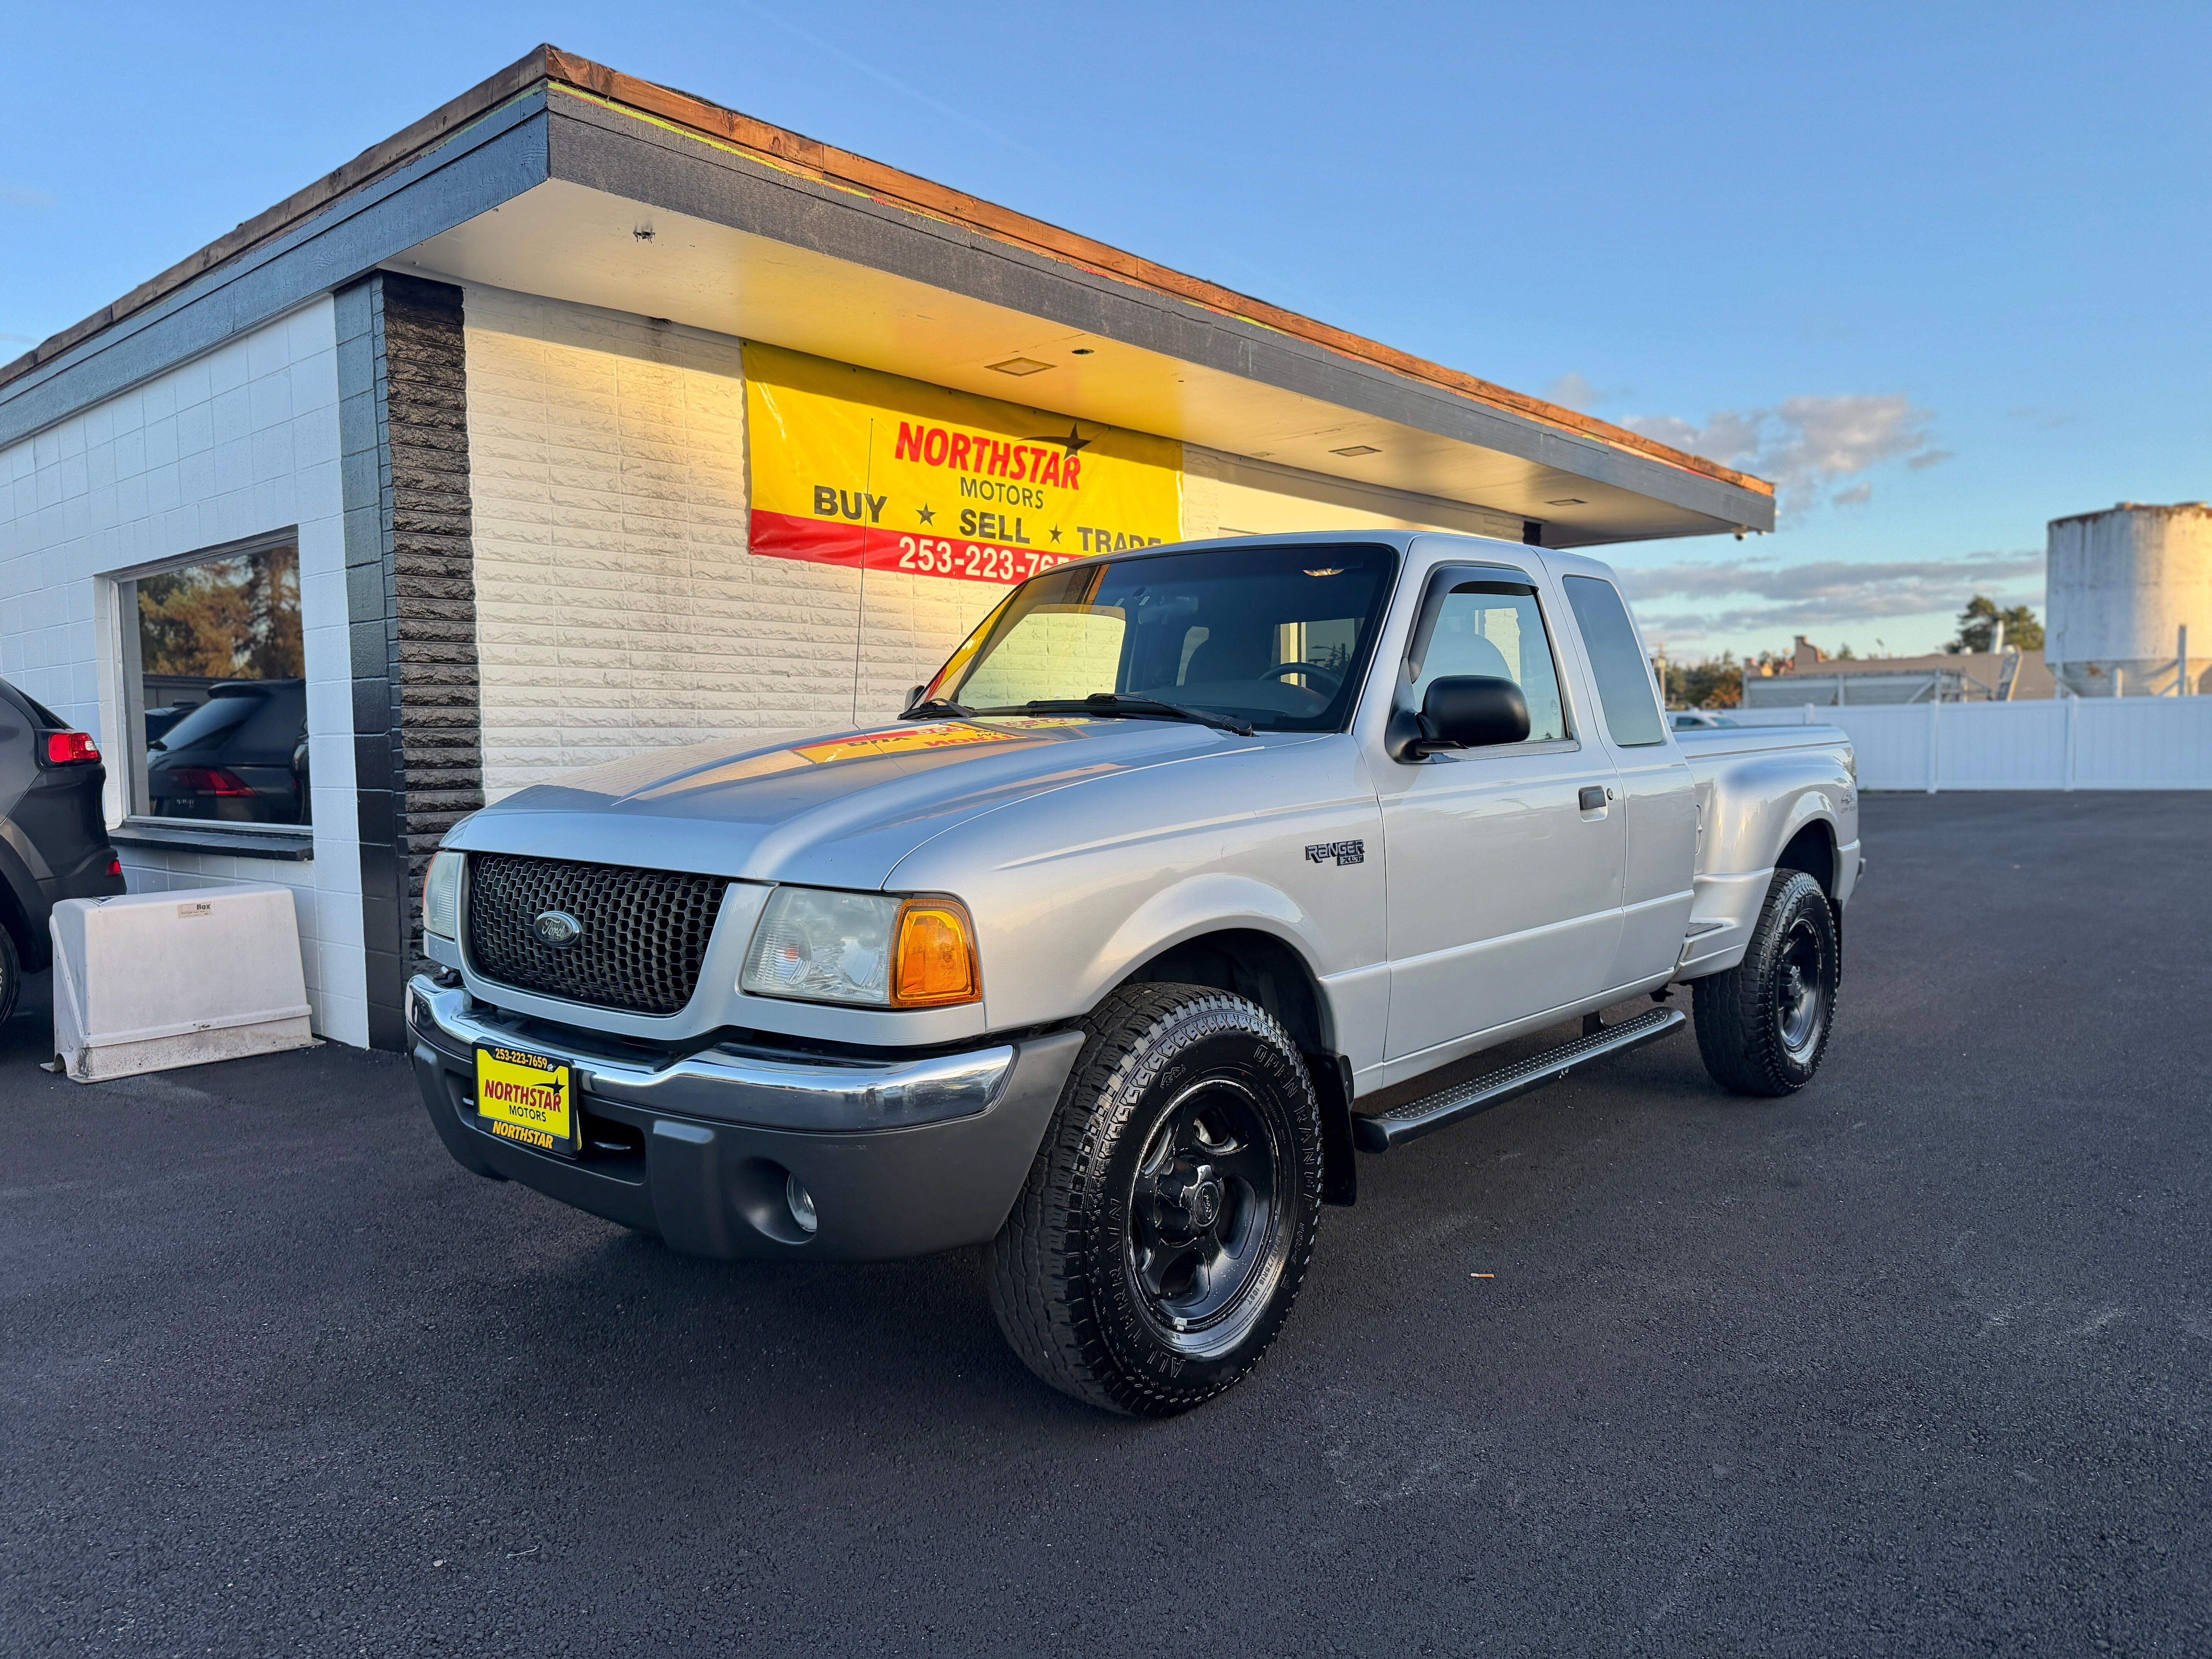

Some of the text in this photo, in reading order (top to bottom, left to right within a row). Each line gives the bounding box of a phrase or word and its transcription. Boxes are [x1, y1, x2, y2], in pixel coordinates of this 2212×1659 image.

[895, 421, 1081, 490] NORTHSTAR
[960, 477, 1044, 509] MOTORS
[814, 485, 888, 523] BUY
[959, 508, 1030, 544] SELL
[899, 536, 1069, 580] 253-223-76
[542, 918, 565, 937] Ford
[495, 1048, 548, 1069] 253-223-7659
[484, 1079, 562, 1113] NORTHSTAR
[509, 1104, 546, 1122] MOTORS
[492, 1120, 554, 1149] NORTHSTAR
